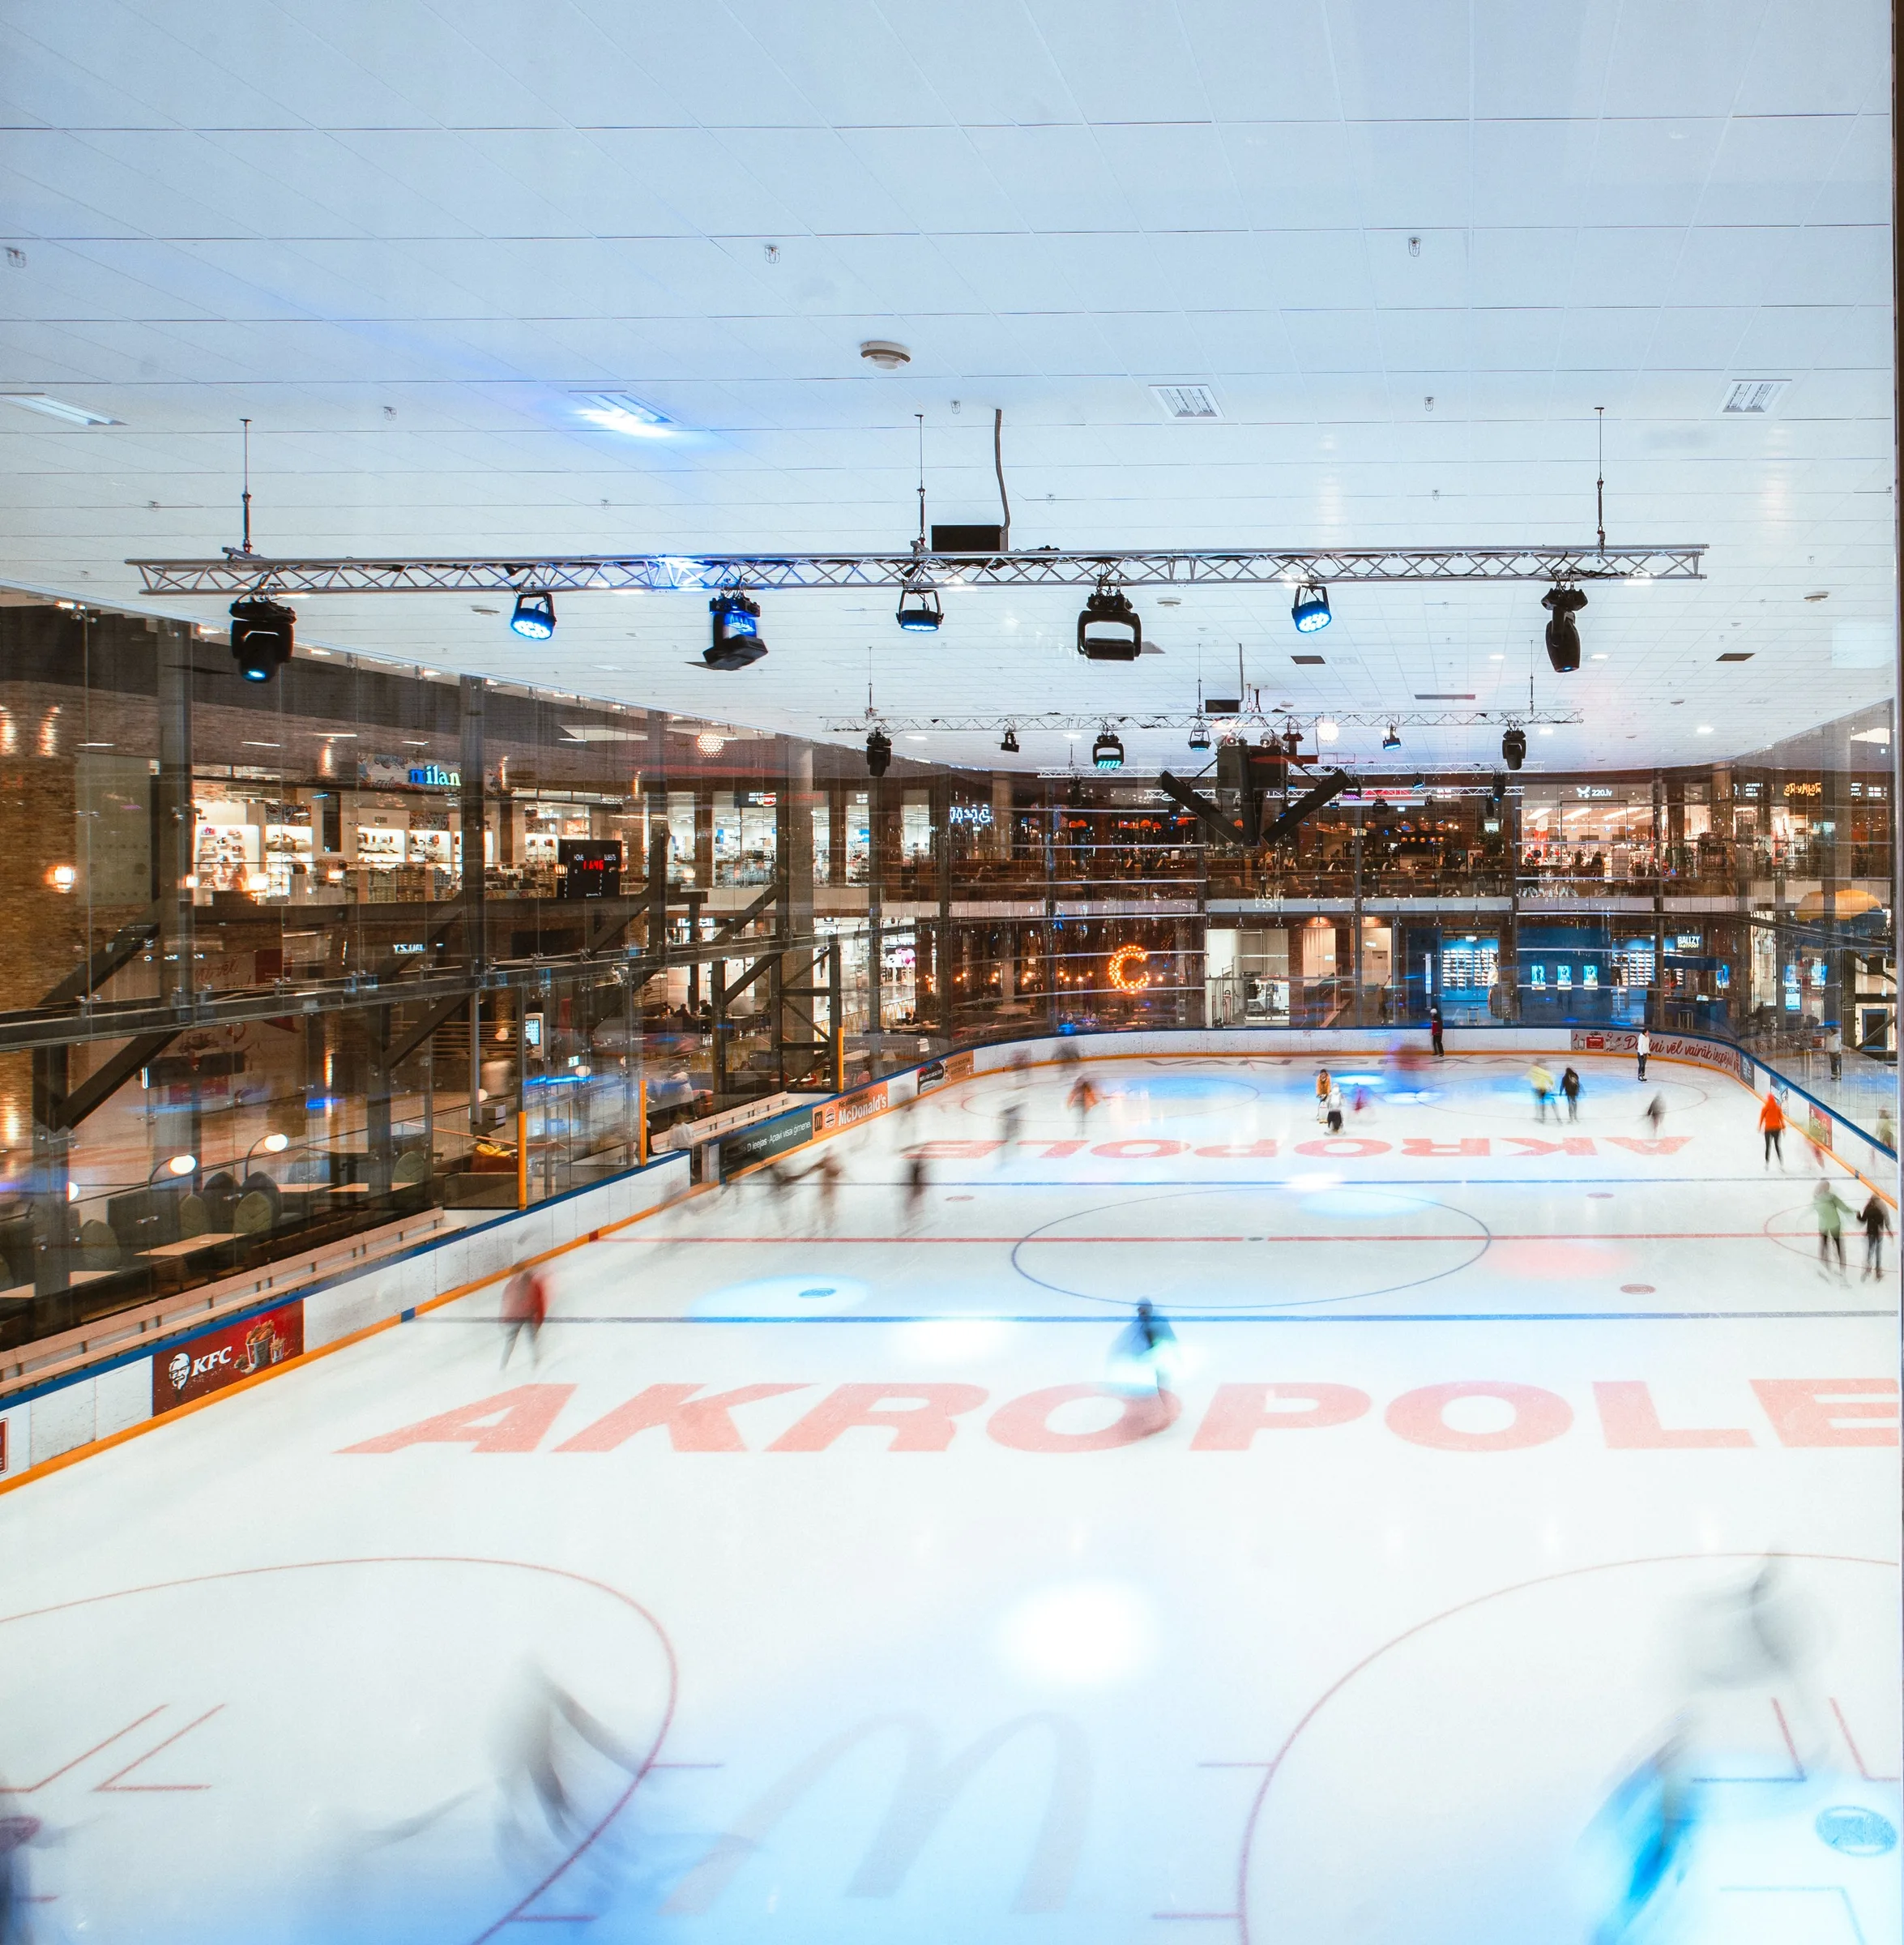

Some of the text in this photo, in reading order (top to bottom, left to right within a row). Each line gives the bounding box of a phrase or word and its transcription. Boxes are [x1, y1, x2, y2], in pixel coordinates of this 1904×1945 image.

[1591, 788, 1612, 797] 220.lv
[1677, 935, 1700, 945] BALLZY
[1107, 943, 1151, 995] C
[1666, 1040, 1684, 1054] vēl
[1685, 1044, 1713, 1059] vairāk
[838, 1093, 887, 1126] McDonald's
[769, 1132, 783, 1143] Apavi
[783, 1126, 793, 1138] visai
[901, 1138, 1693, 1161] AKROPOLE
[190, 1346, 233, 1377] KFC
[331, 1378, 1899, 1454] AKROPOLE
